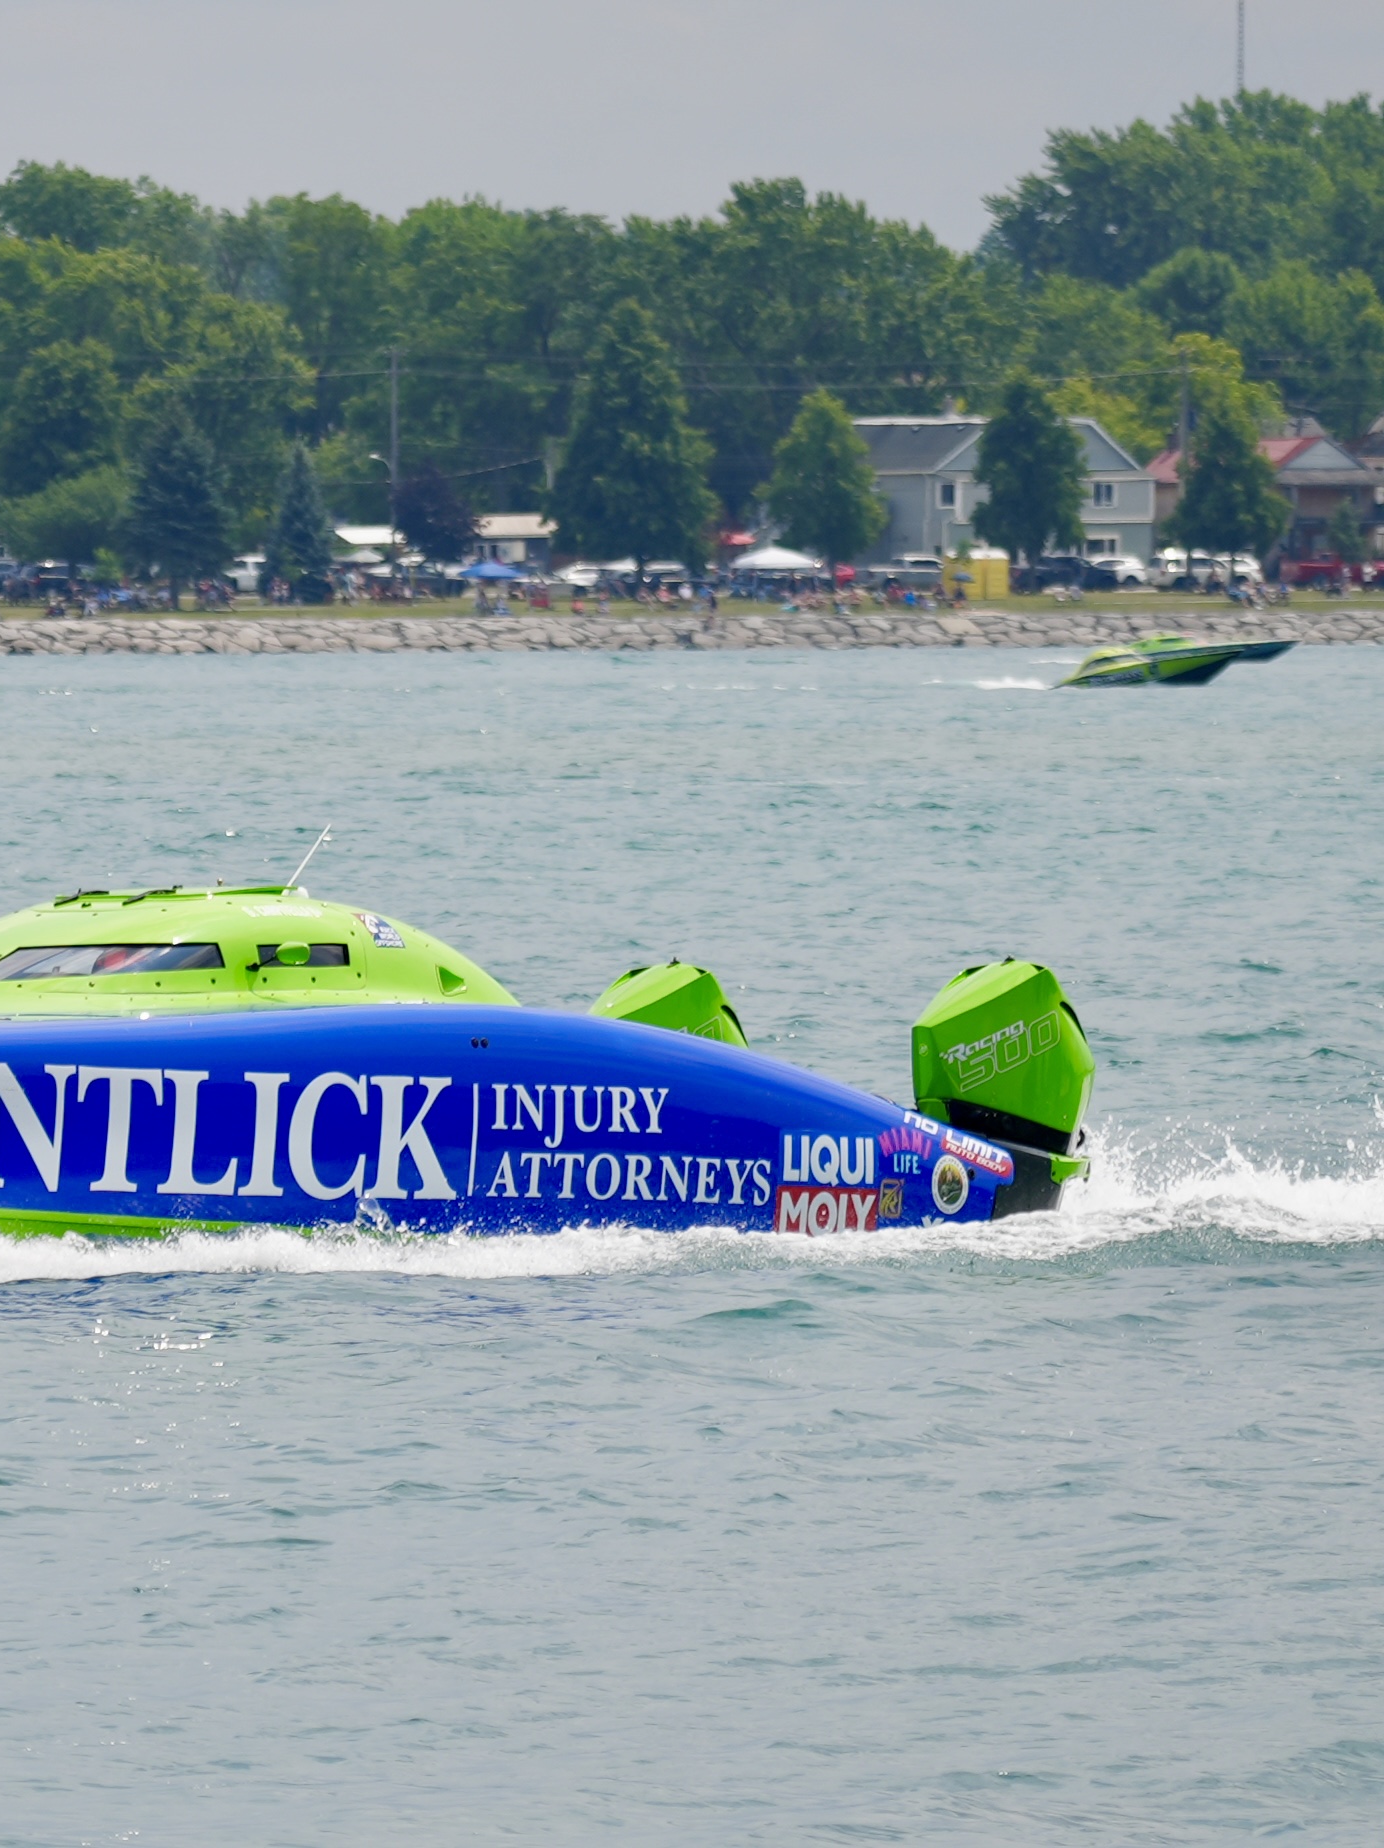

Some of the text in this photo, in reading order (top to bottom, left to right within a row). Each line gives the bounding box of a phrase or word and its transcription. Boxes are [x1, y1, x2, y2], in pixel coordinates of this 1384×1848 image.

[959, 1010, 1061, 1093] 500
[491, 1083, 669, 1148] INJURY
[783, 1134, 875, 1186] LIQUI
[878, 1126, 932, 1160] MIAMI
[945, 1143, 1007, 1173] AUTO BODY
[946, 1129, 1010, 1163] LIMIT
[486, 1151, 772, 1206] ATTORNEYS
[778, 1191, 877, 1236] MOLY
